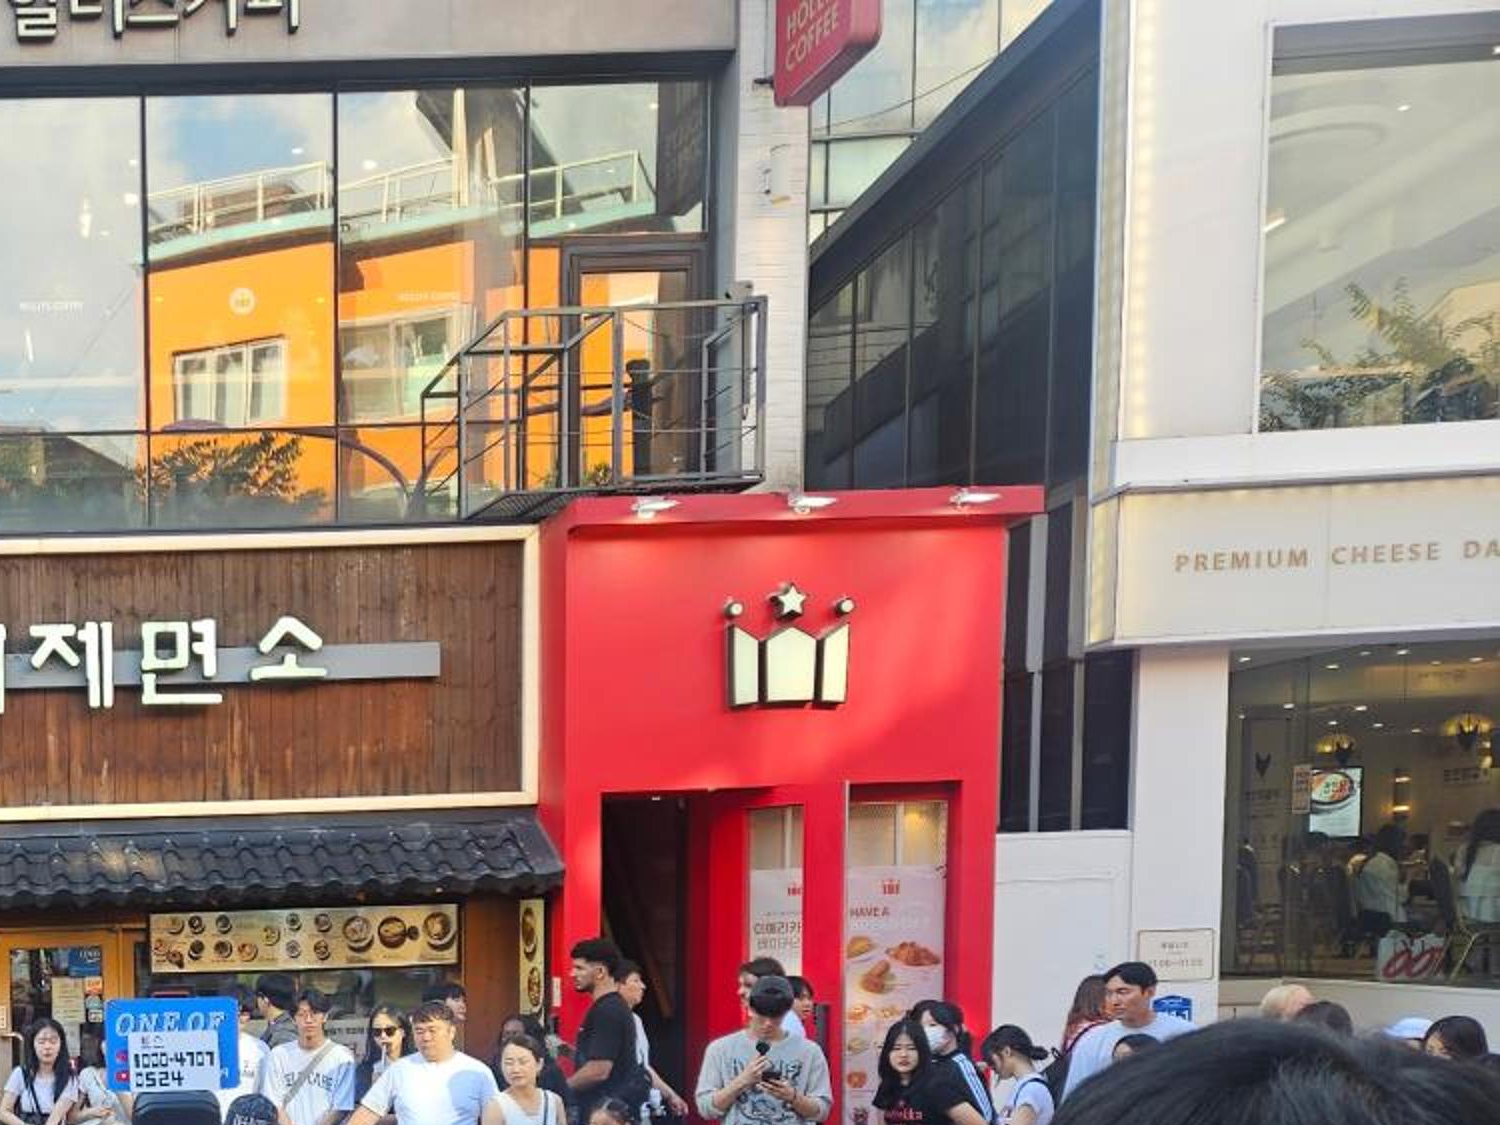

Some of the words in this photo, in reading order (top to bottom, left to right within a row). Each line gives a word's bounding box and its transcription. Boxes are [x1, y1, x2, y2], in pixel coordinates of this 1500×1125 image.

[786, 3, 838, 72] COFFEE
[1175, 548, 1309, 573] PREMIUM
[1331, 541, 1441, 565] CHEESE
[116, 1011, 181, 1036] ONE
[135, 1071, 184, 1088] 0524
